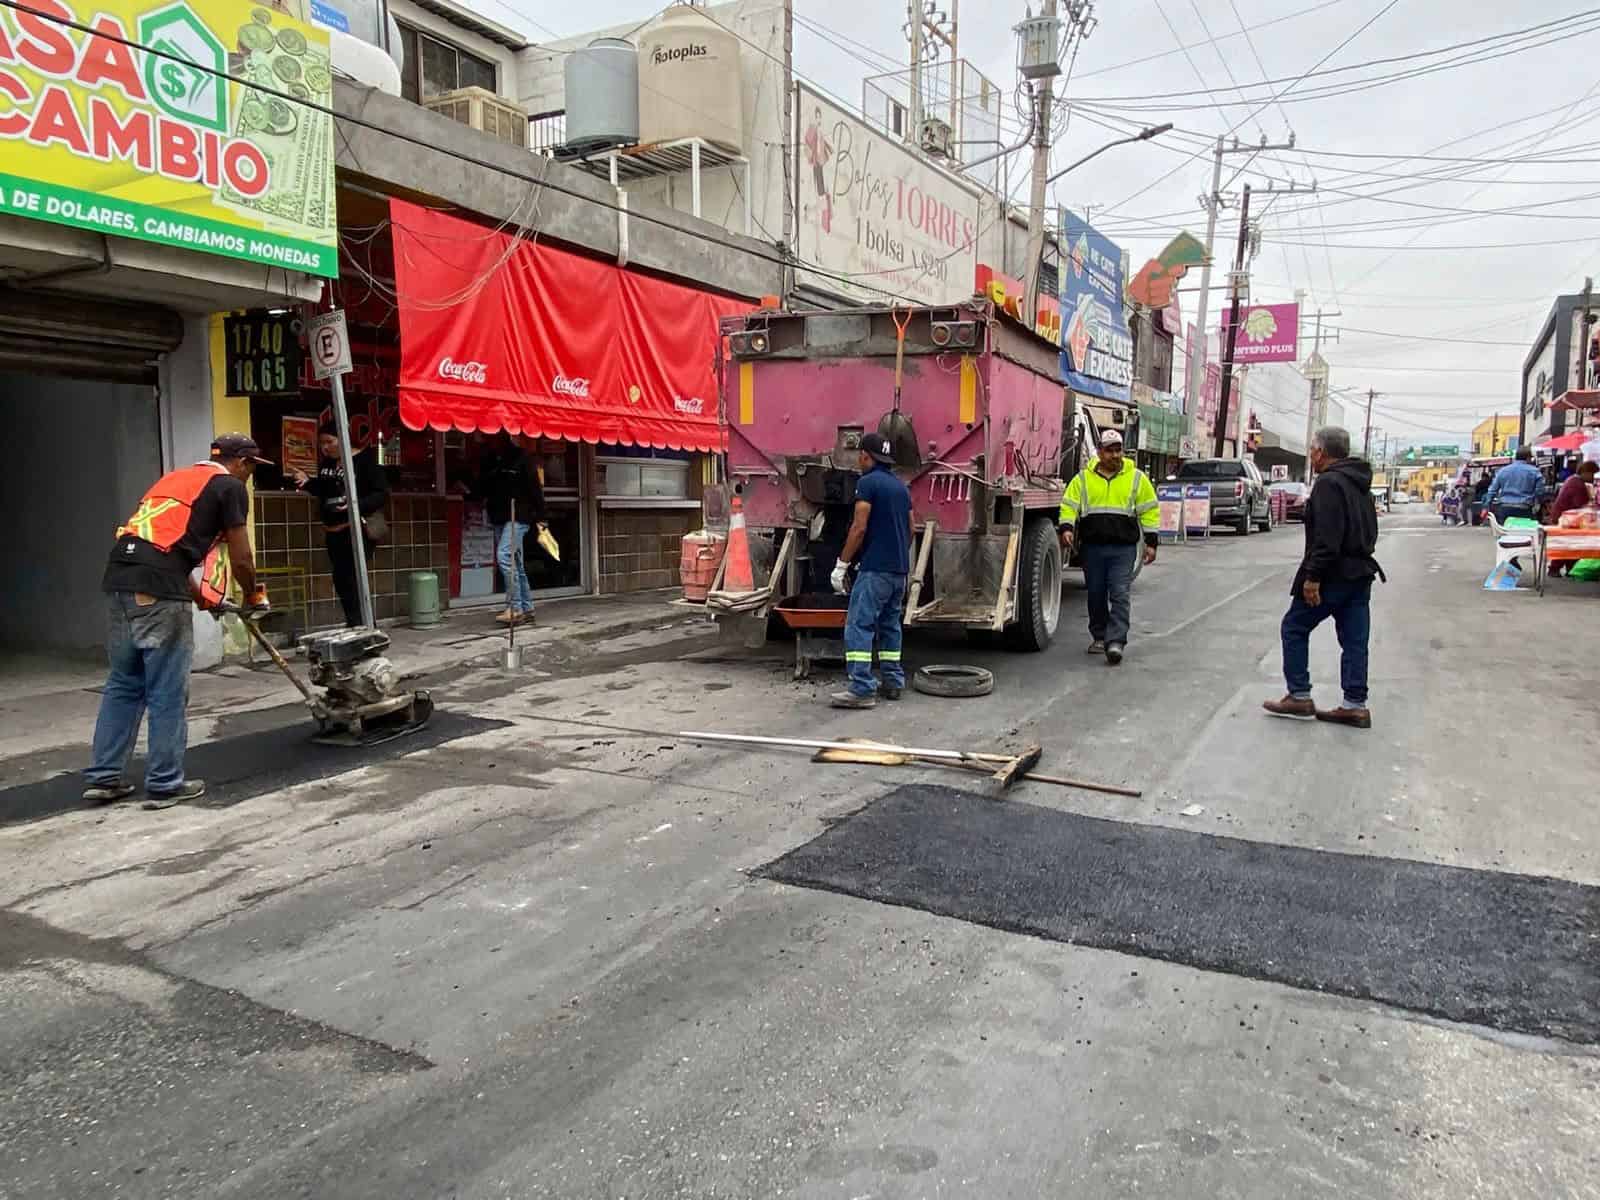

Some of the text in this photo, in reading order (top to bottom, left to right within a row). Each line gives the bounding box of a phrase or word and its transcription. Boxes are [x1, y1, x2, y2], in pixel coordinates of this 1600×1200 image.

[0, 0, 146, 98] SA
[654, 43, 707, 64] Rotoplas
[12, 190, 41, 211] DE
[46, 196, 138, 232] DOLARES,
[144, 218, 245, 252] CAMBIAMOS
[250, 241, 320, 268] MONEDAS
[895, 176, 973, 255] TORRES
[866, 219, 904, 263] bolsa
[232, 322, 283, 356] 17.40
[233, 356, 286, 392] 18.65
